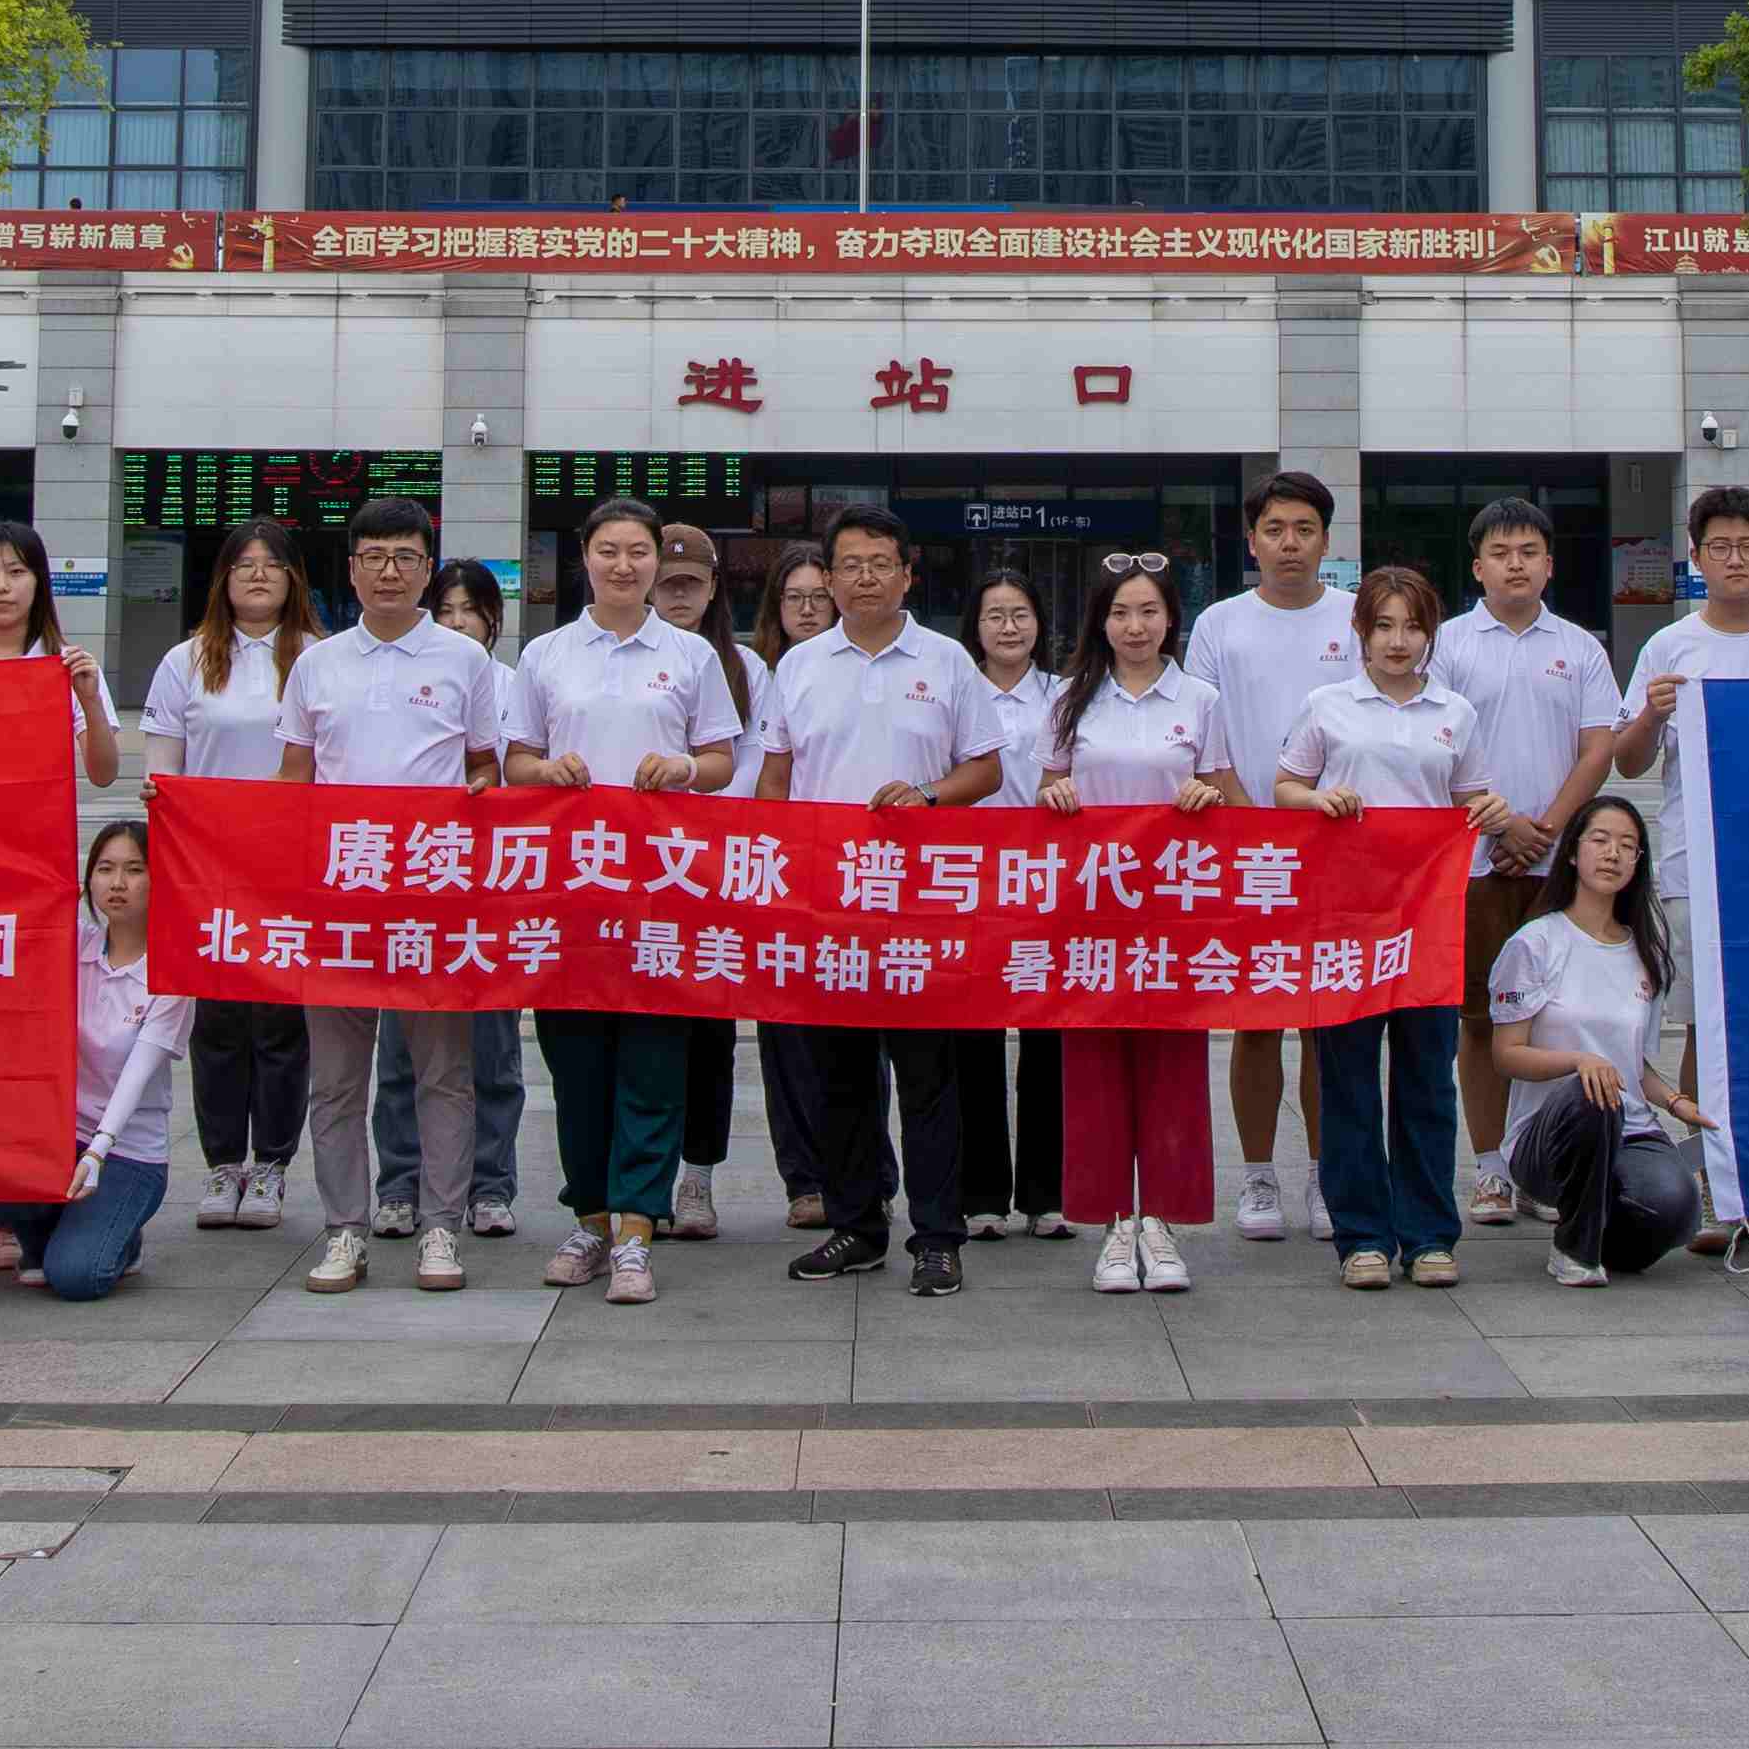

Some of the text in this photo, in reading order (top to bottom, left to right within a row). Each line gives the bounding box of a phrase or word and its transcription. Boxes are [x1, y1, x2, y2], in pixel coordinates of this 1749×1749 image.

[679, 356, 1133, 414] 进站口
[991, 505, 1033, 520] 进站口
[1035, 505, 1046, 528] 1
[322, 818, 1304, 915] 赓续历史文脉 谱写时代华章
